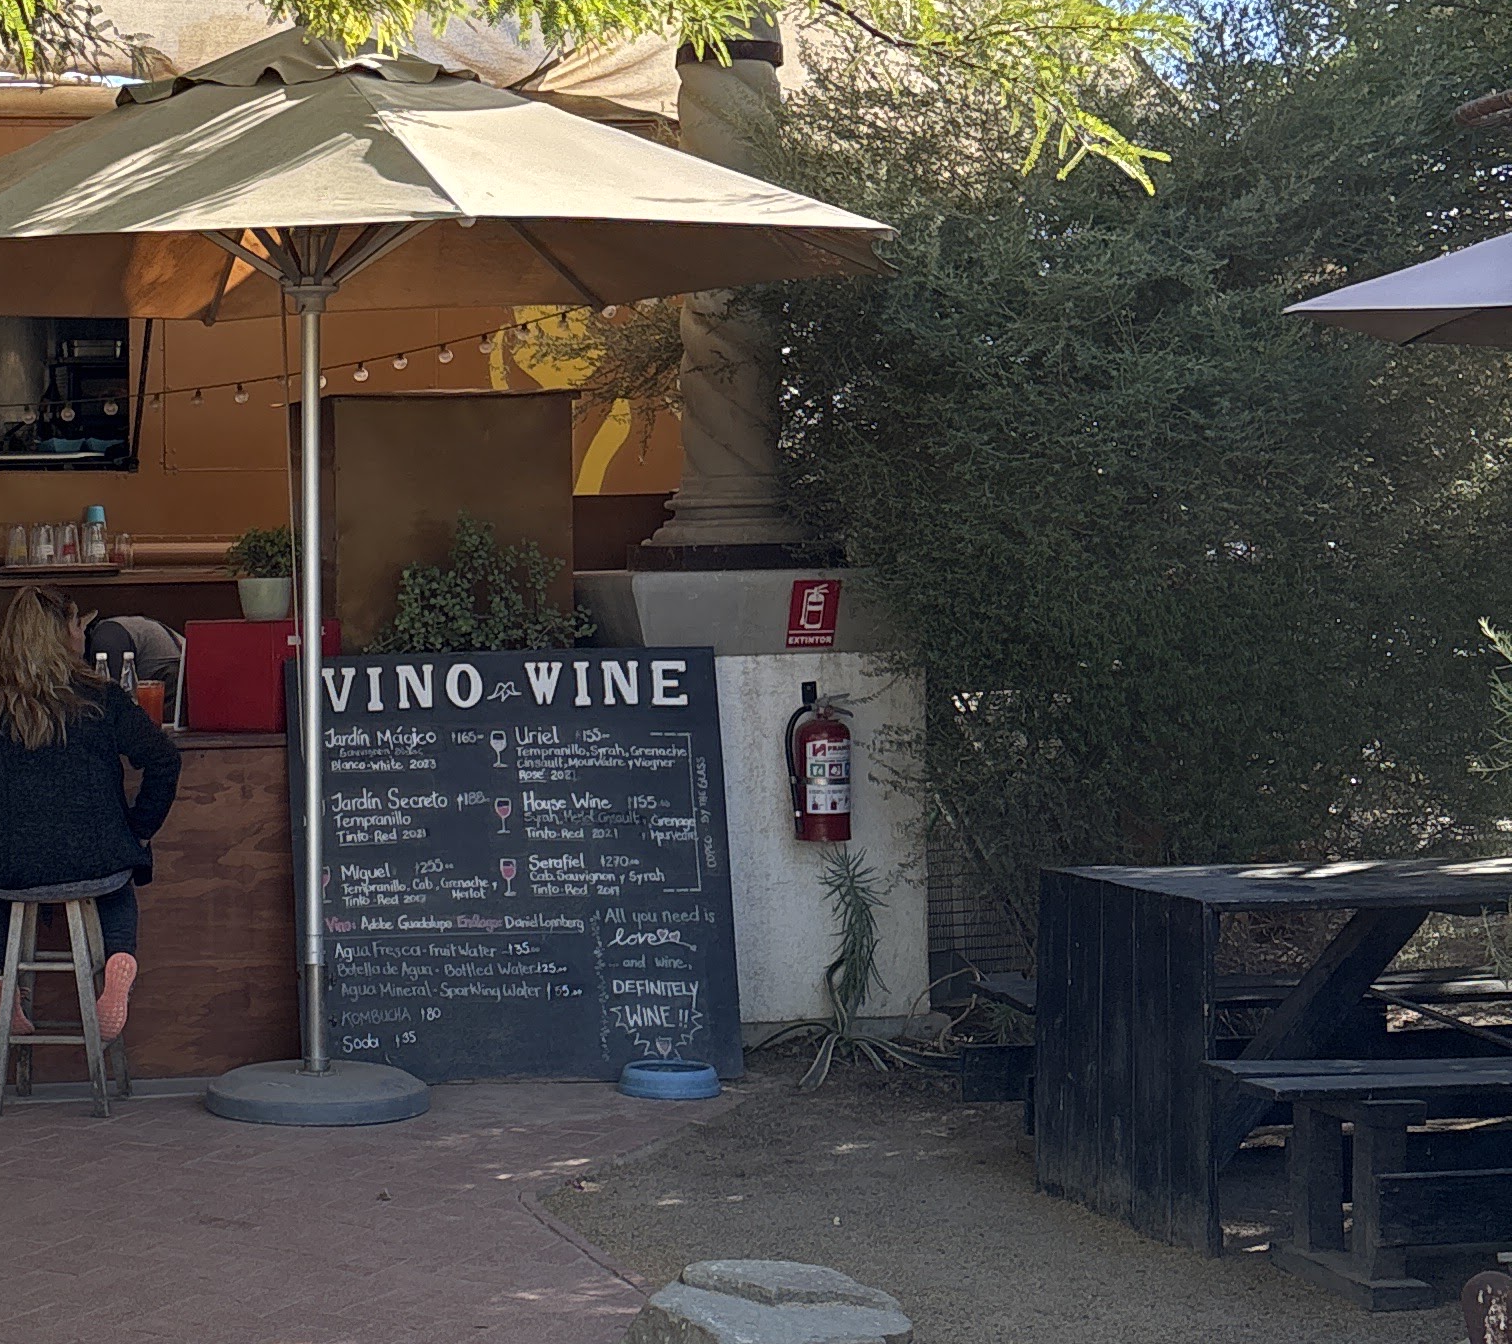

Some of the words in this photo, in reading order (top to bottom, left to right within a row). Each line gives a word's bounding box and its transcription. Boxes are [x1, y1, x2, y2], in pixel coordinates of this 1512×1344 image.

[788, 636, 833, 645] EXTINTOR
[322, 663, 483, 712] VINO
[524, 660, 688, 706] WINE
[325, 726, 370, 748] Jardín
[377, 726, 437, 750] Mágico
[515, 726, 560, 744] Uriel
[516, 744, 589, 760] Tempranillo,
[695, 756, 709, 788] GLASS
[332, 788, 382, 811] Jardín
[388, 788, 448, 809] Secreto
[522, 790, 566, 812] House
[571, 791, 612, 810] Wine
[333, 811, 411, 829] Tempranillo
[402, 828, 426, 840] 2021
[528, 852, 585, 871] Serafiel
[341, 863, 391, 883] Miguel
[556, 870, 616, 884] Sauvignon
[629, 868, 666, 885] Syrah
[342, 879, 410, 895] Tempranillo,
[440, 876, 490, 888] Grenache
[397, 914, 453, 934] Guadalupe
[504, 913, 538, 929] Daniel
[604, 908, 626, 924] All
[632, 911, 657, 930] you
[661, 905, 700, 923] need
[704, 908, 716, 923] is
[608, 927, 657, 946] love
[334, 942, 370, 962] Agua
[458, 943, 496, 958] Water
[336, 962, 380, 977] Botella
[381, 962, 396, 975] de
[400, 963, 433, 981] Agua
[497, 963, 533, 975] Water
[341, 983, 377, 1002] Agua
[380, 981, 431, 997] Mineral
[501, 982, 541, 998] Water
[612, 978, 699, 999] DEFINITELY
[341, 1007, 411, 1026] KOMBUCHA
[624, 1003, 675, 1028] WINE
[342, 1033, 380, 1053] Soda
